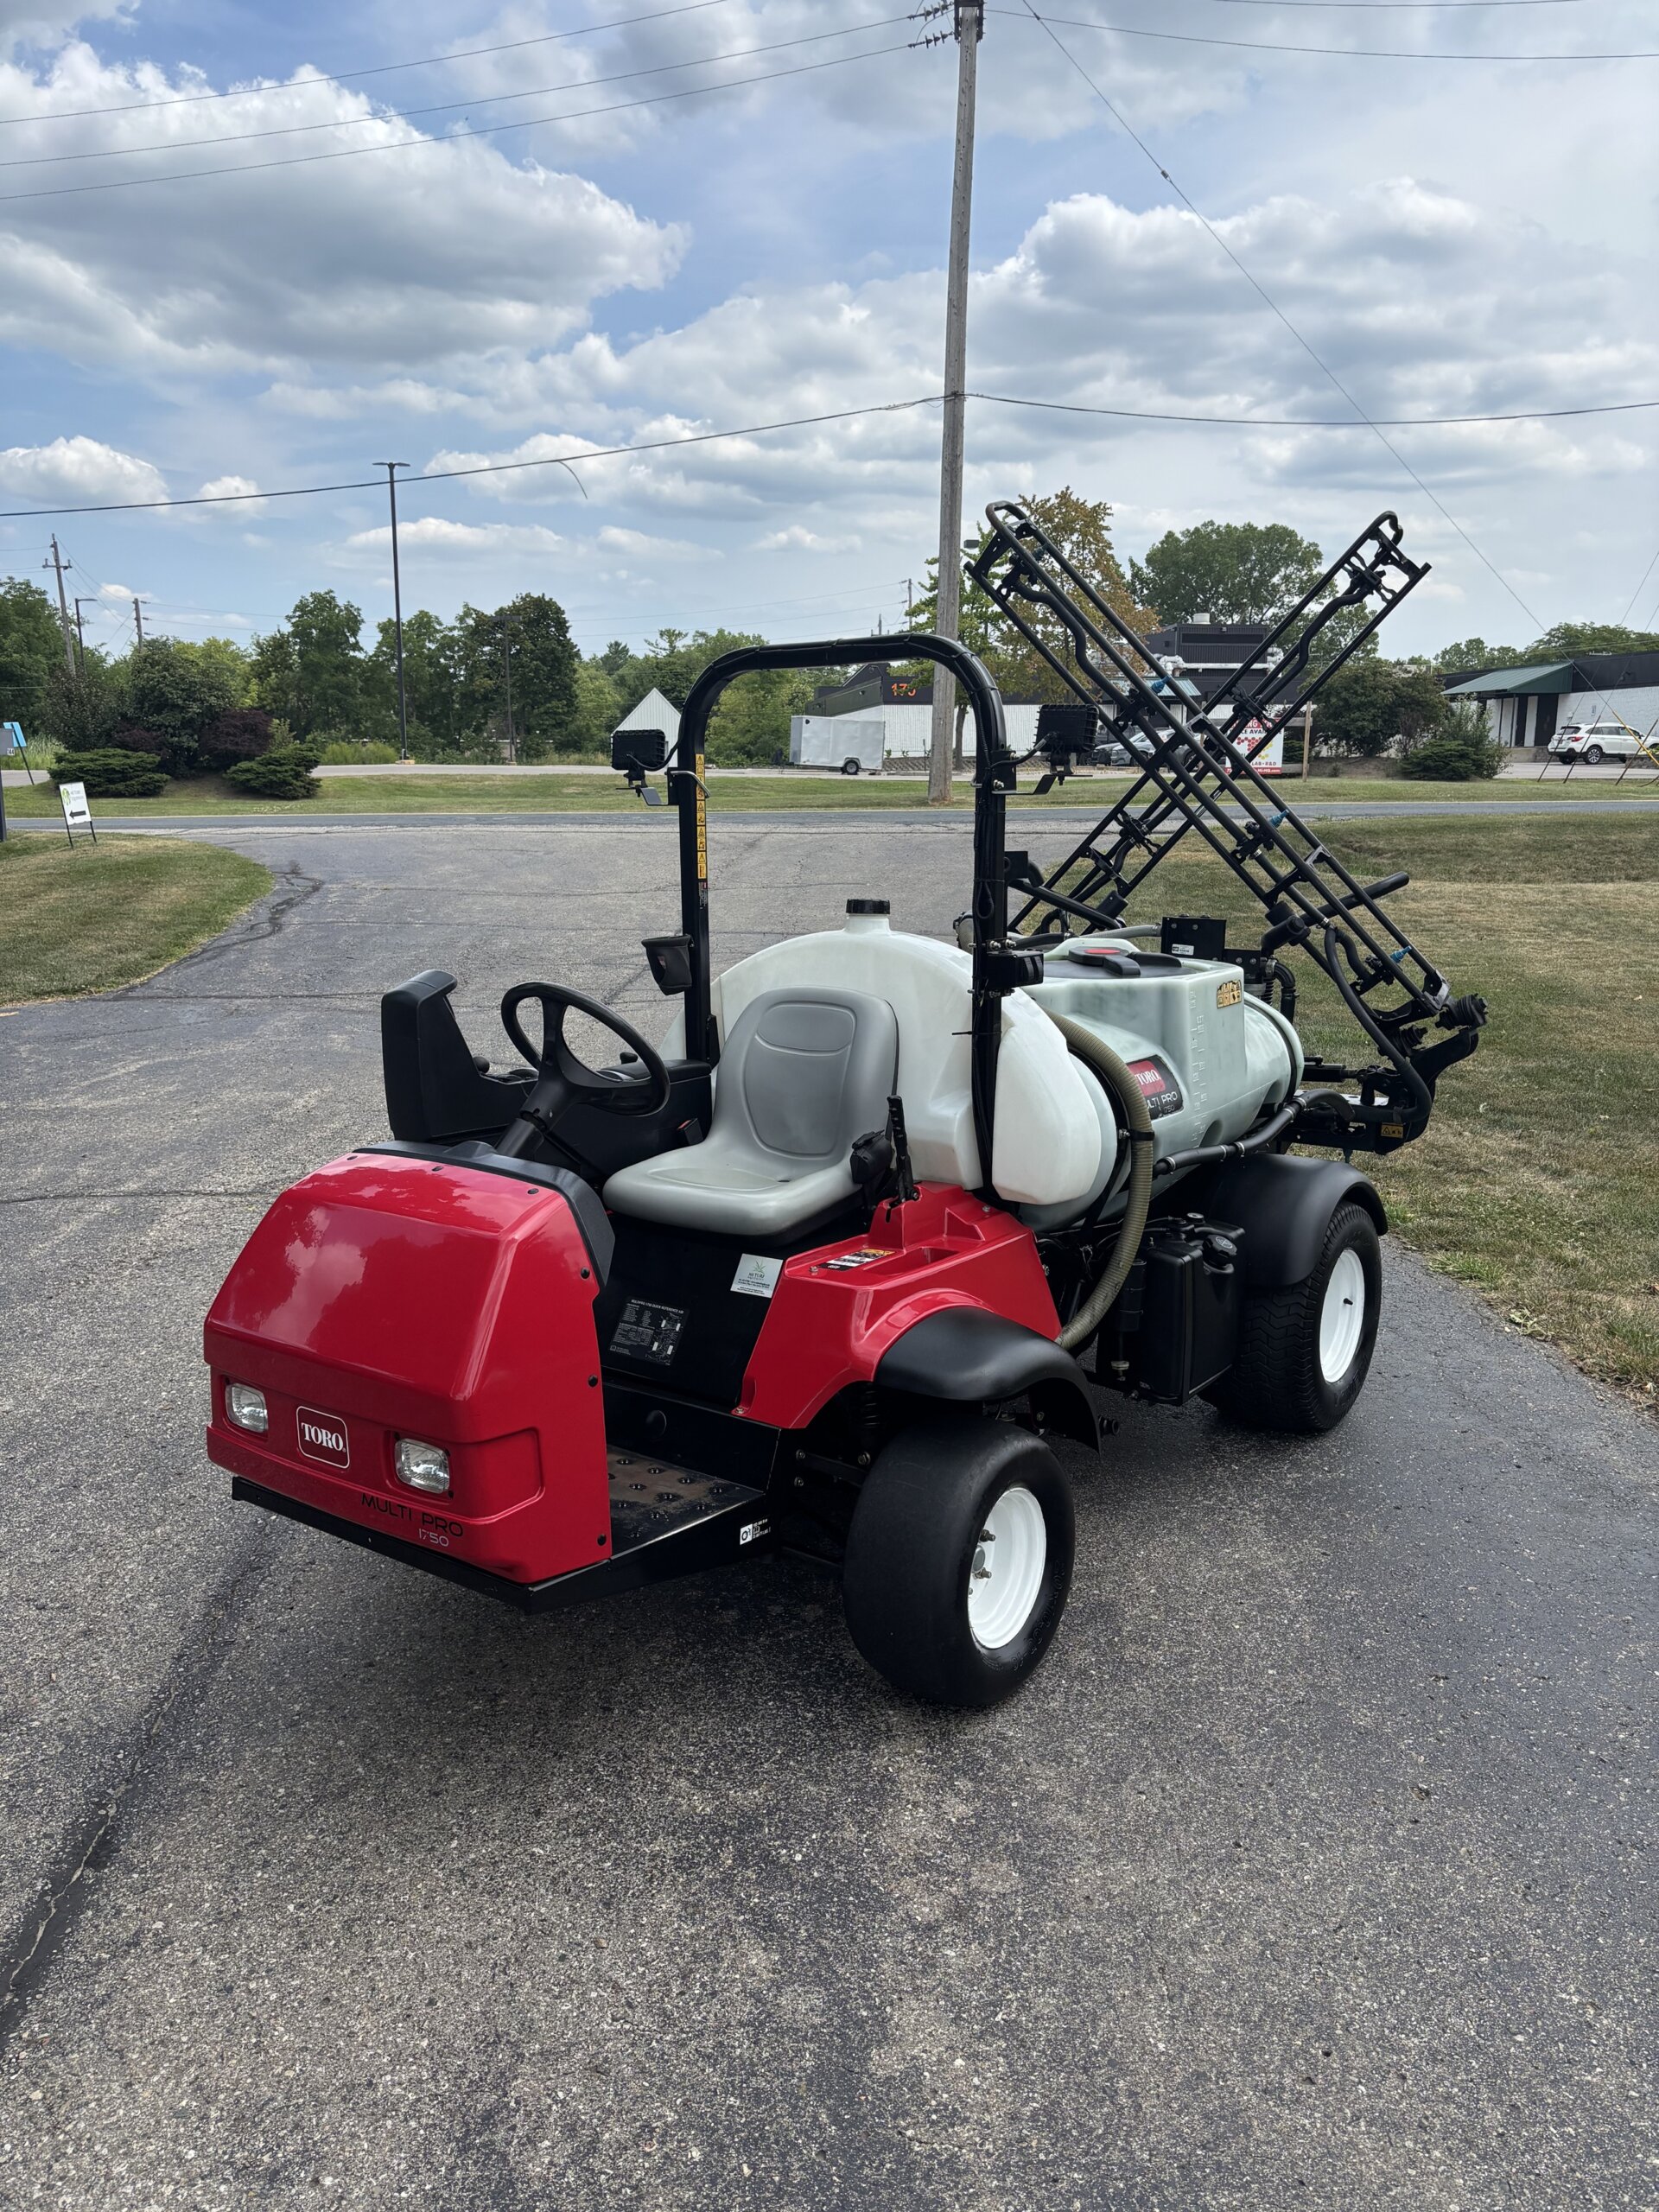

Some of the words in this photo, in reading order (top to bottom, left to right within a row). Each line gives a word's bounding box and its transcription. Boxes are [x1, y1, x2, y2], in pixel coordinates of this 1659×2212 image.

[1135, 1070, 1161, 1085] TORO
[1160, 1091, 1178, 1104] PRO
[301, 1422, 345, 1452] TORO
[361, 1493, 412, 1522] MULTI
[421, 1512, 464, 1537] PRO
[418, 1528, 449, 1547] 1750
